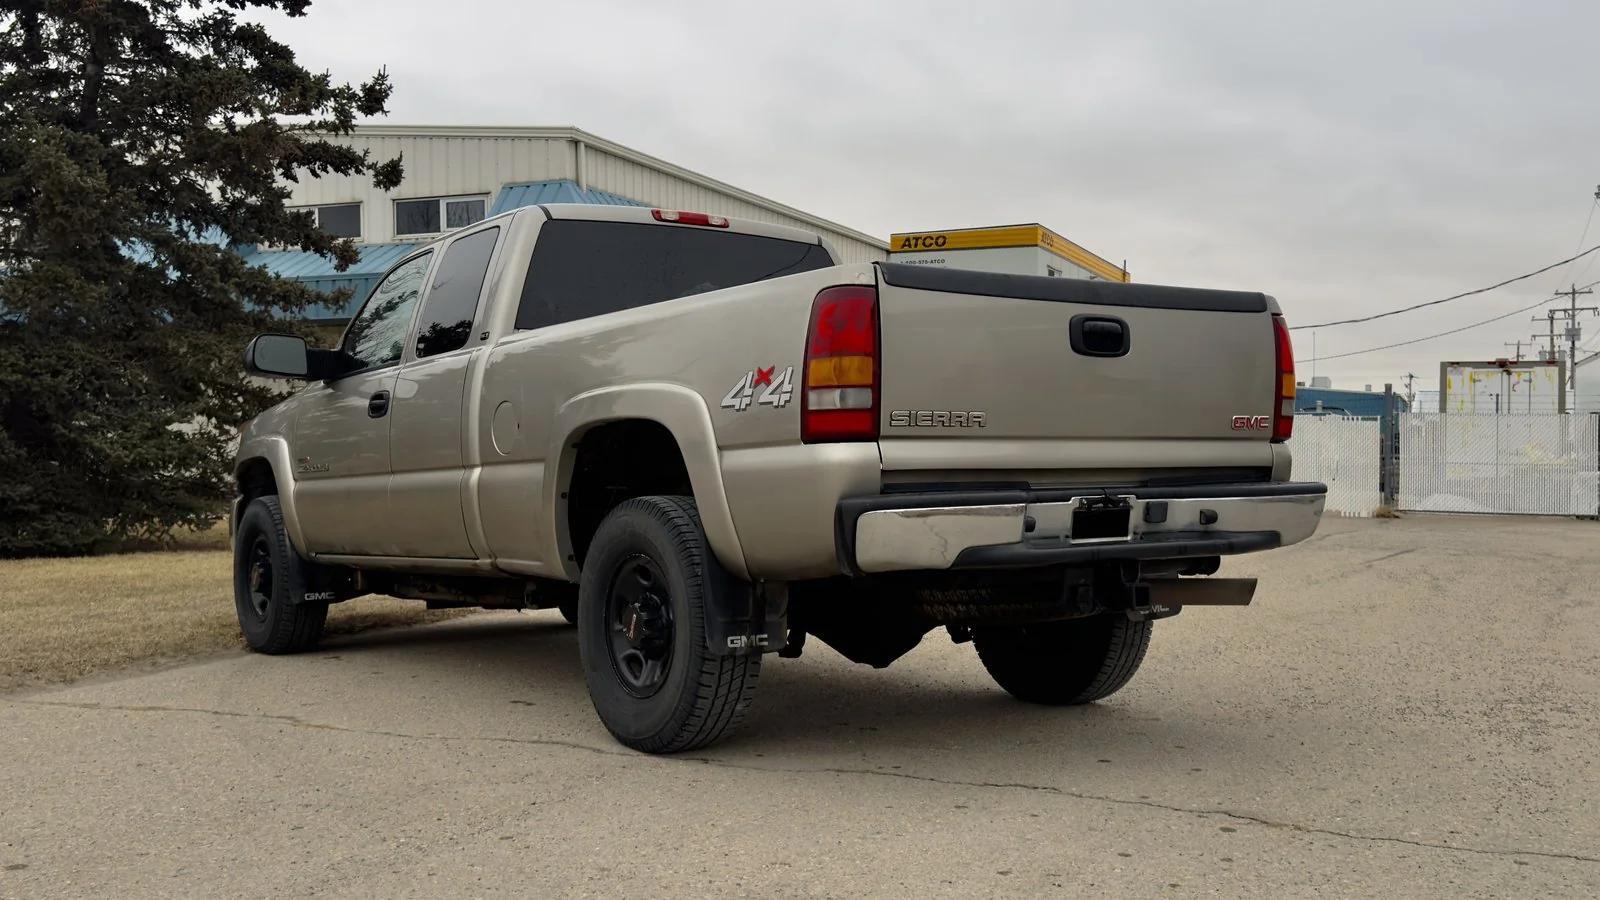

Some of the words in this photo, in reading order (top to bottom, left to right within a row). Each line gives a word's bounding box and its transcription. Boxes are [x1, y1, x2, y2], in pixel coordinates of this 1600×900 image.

[900, 235, 948, 250] ATCO
[890, 410, 987, 427] SIERRA
[1231, 415, 1270, 430] GMC
[304, 591, 336, 601] GMC
[727, 633, 769, 648] GMC
